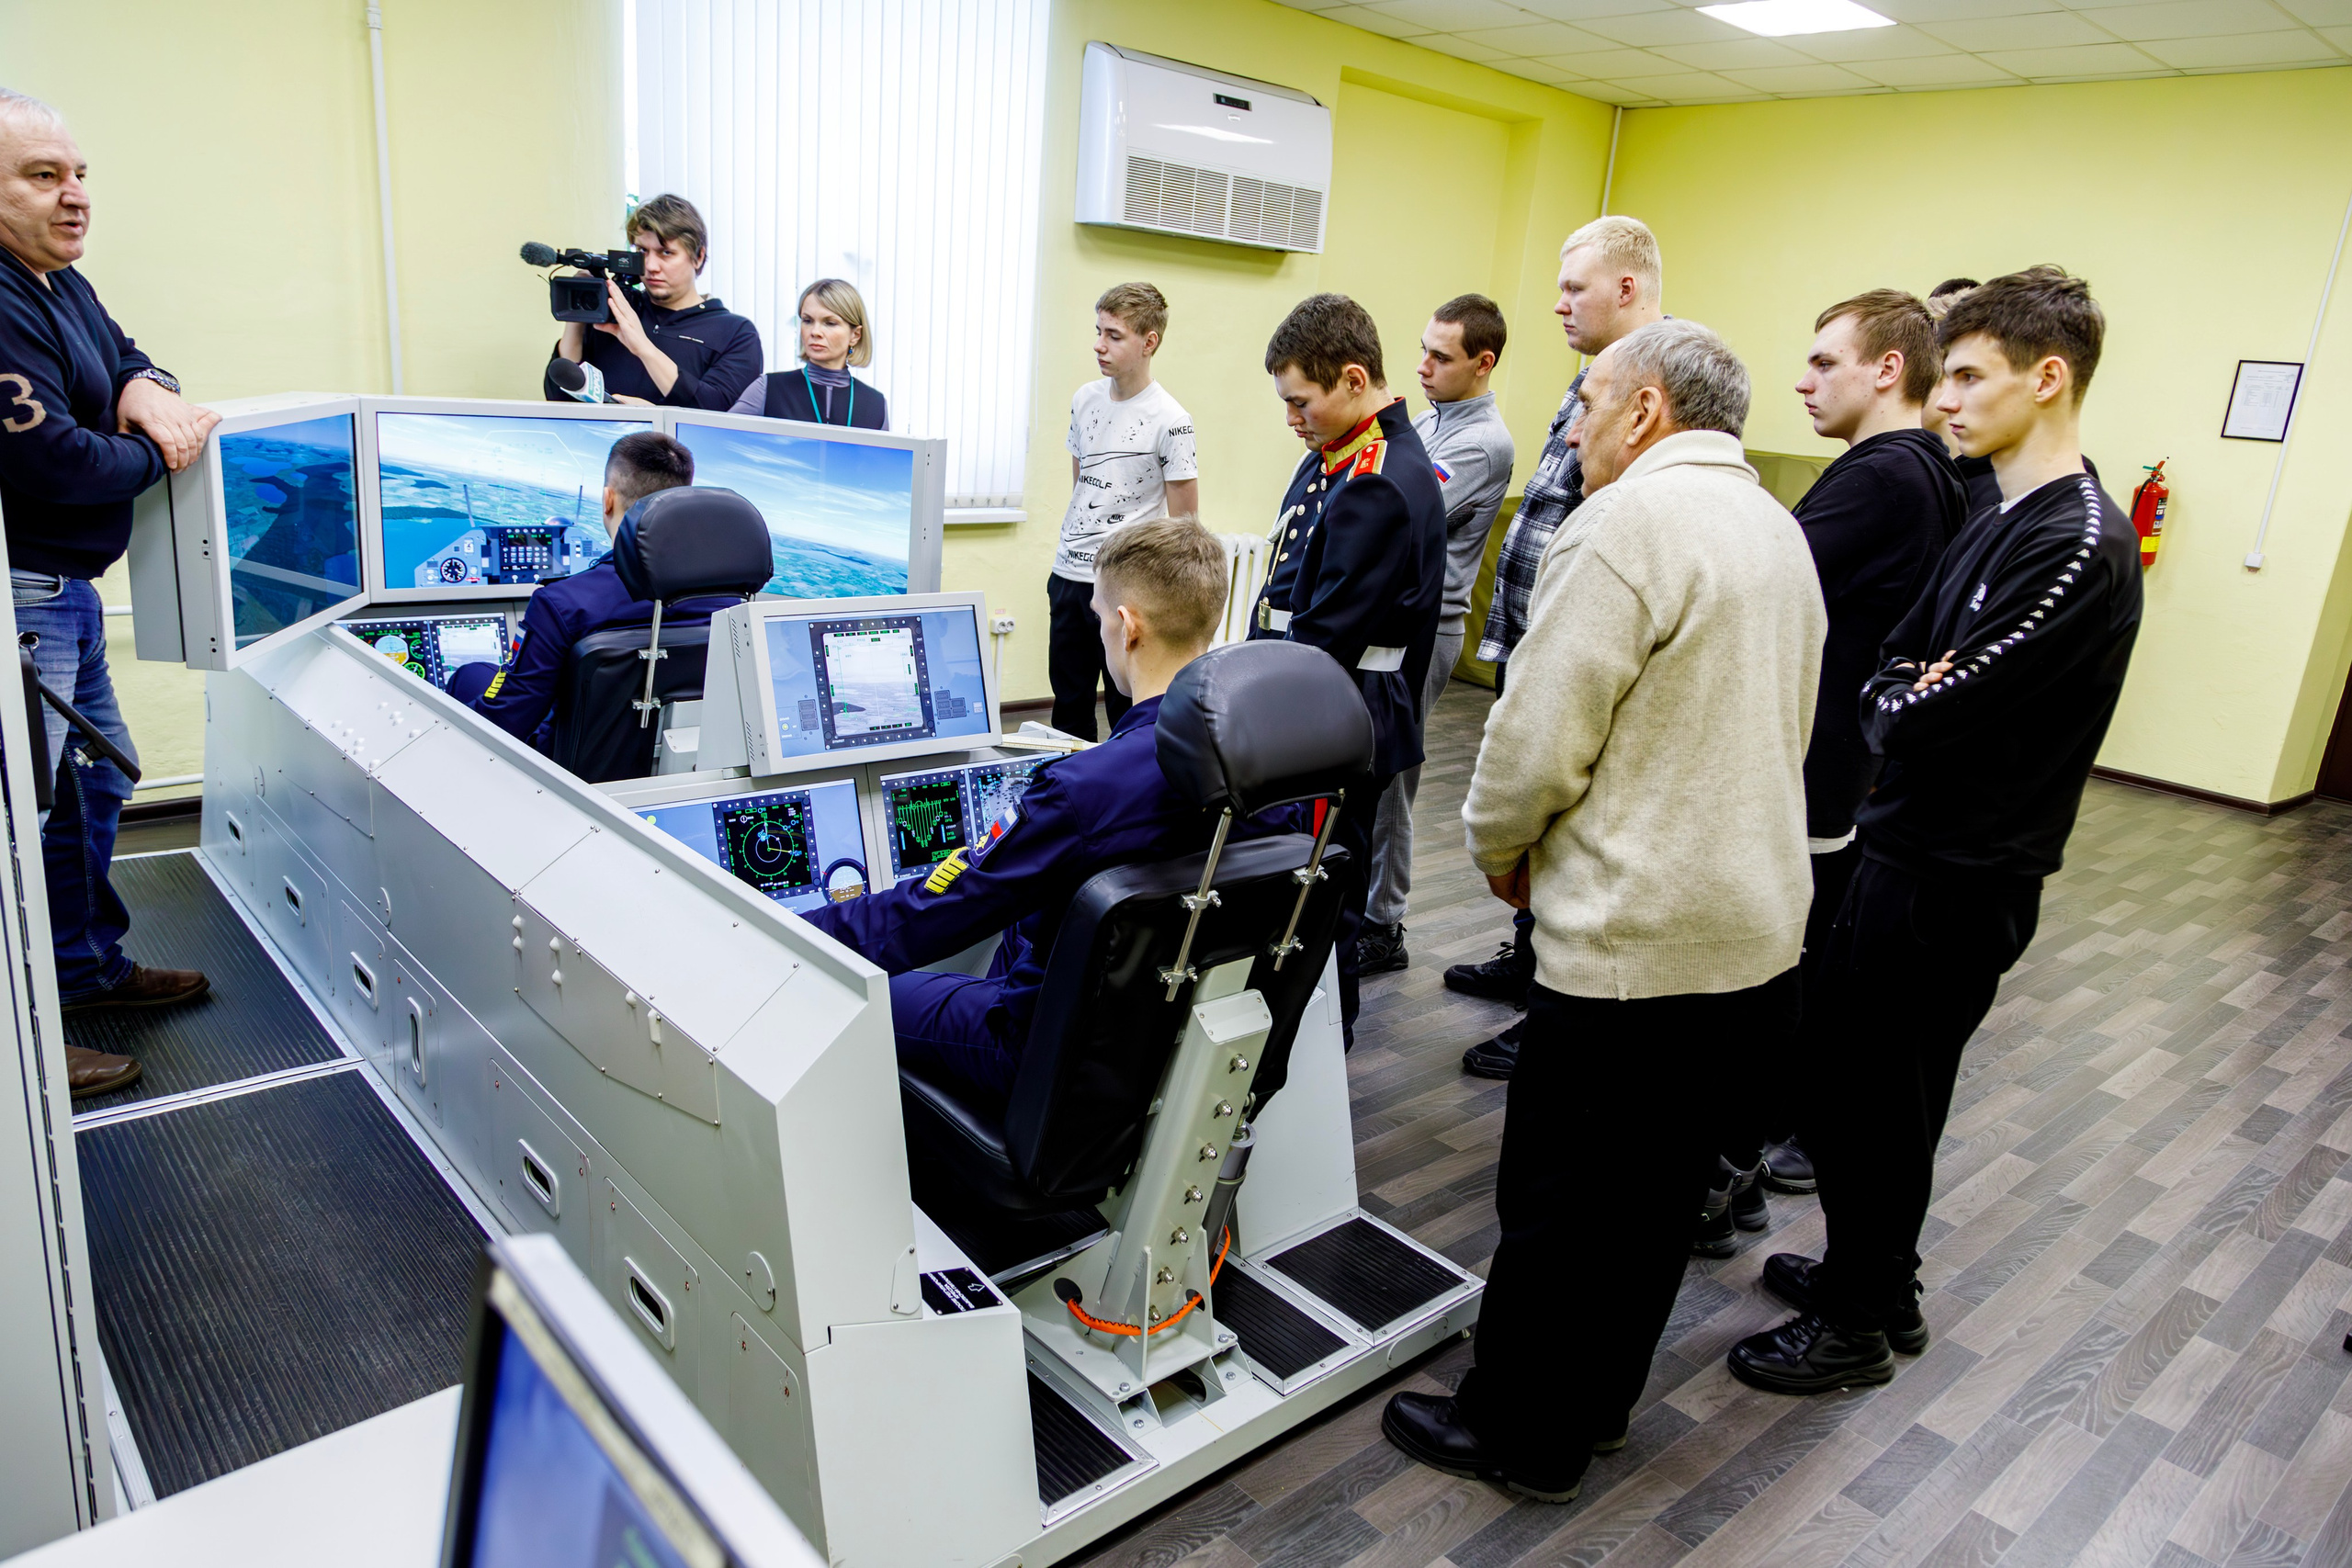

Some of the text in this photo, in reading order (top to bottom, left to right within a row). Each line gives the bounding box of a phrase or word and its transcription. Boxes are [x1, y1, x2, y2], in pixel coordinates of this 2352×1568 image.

[0, 373, 47, 433] 3
[1169, 425, 1194, 437] NIKEG
[1110, 513, 1126, 522] NIKE
